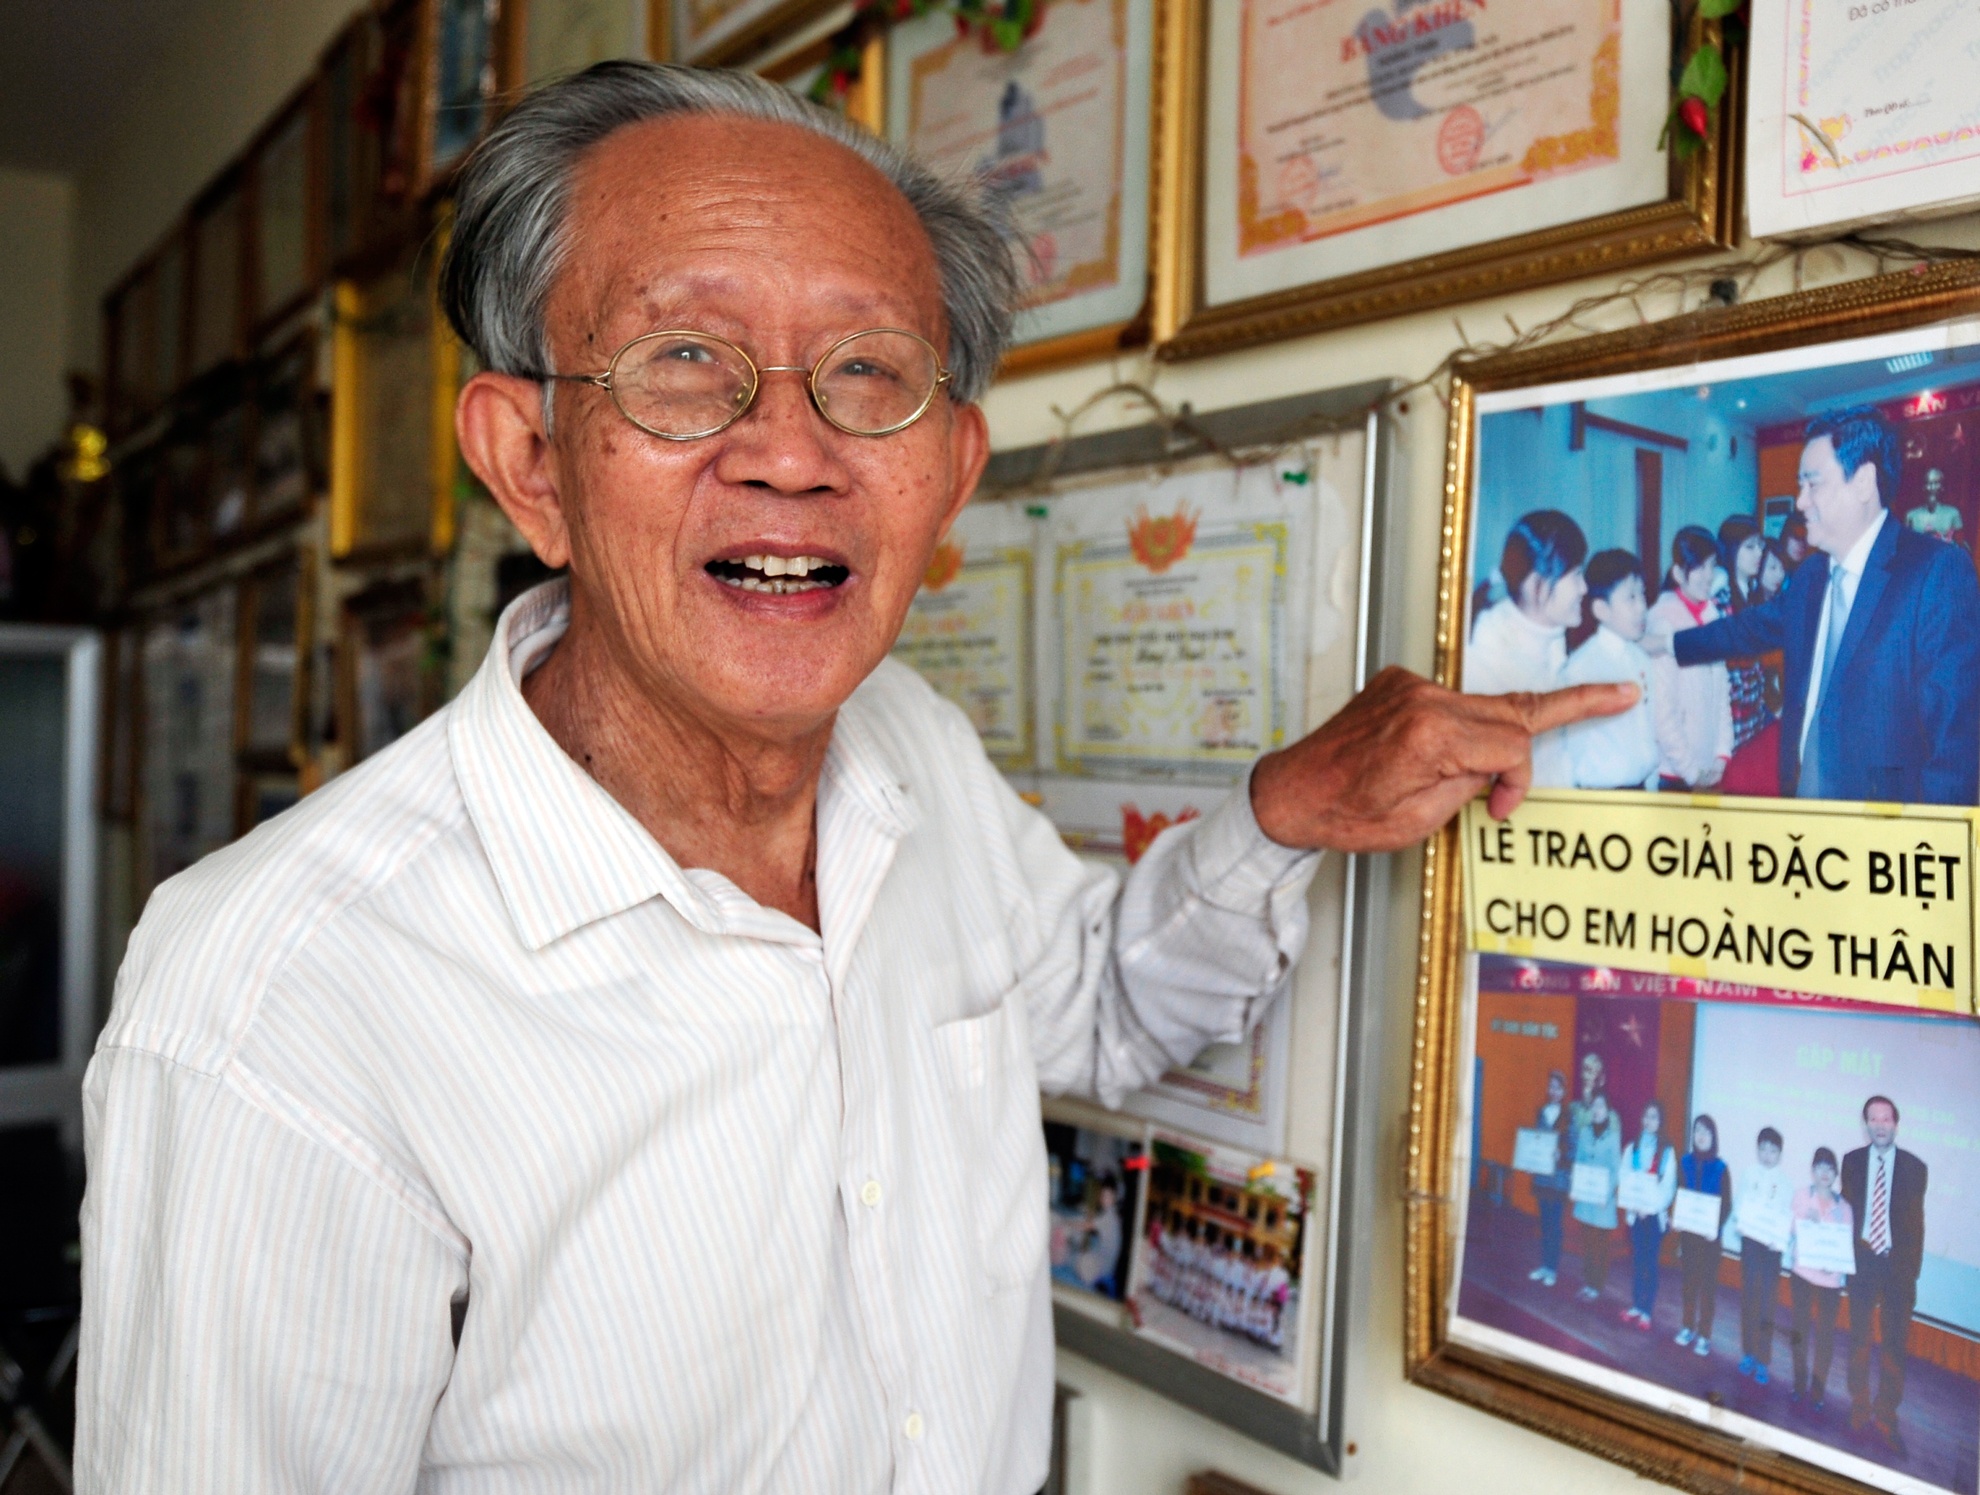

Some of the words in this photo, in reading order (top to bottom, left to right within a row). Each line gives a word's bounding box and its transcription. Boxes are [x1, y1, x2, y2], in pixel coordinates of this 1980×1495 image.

[1527, 829, 1633, 873] TRAO
[1646, 822, 1733, 882] GIẢI
[1748, 833, 1851, 899] ĐẶC
[1868, 841, 1961, 911] BIỆT
[1486, 898, 1570, 941] CHO
[1584, 907, 1637, 950] EM
[1651, 907, 1815, 971] HOÀNG
[1827, 928, 1955, 990] THÂN
